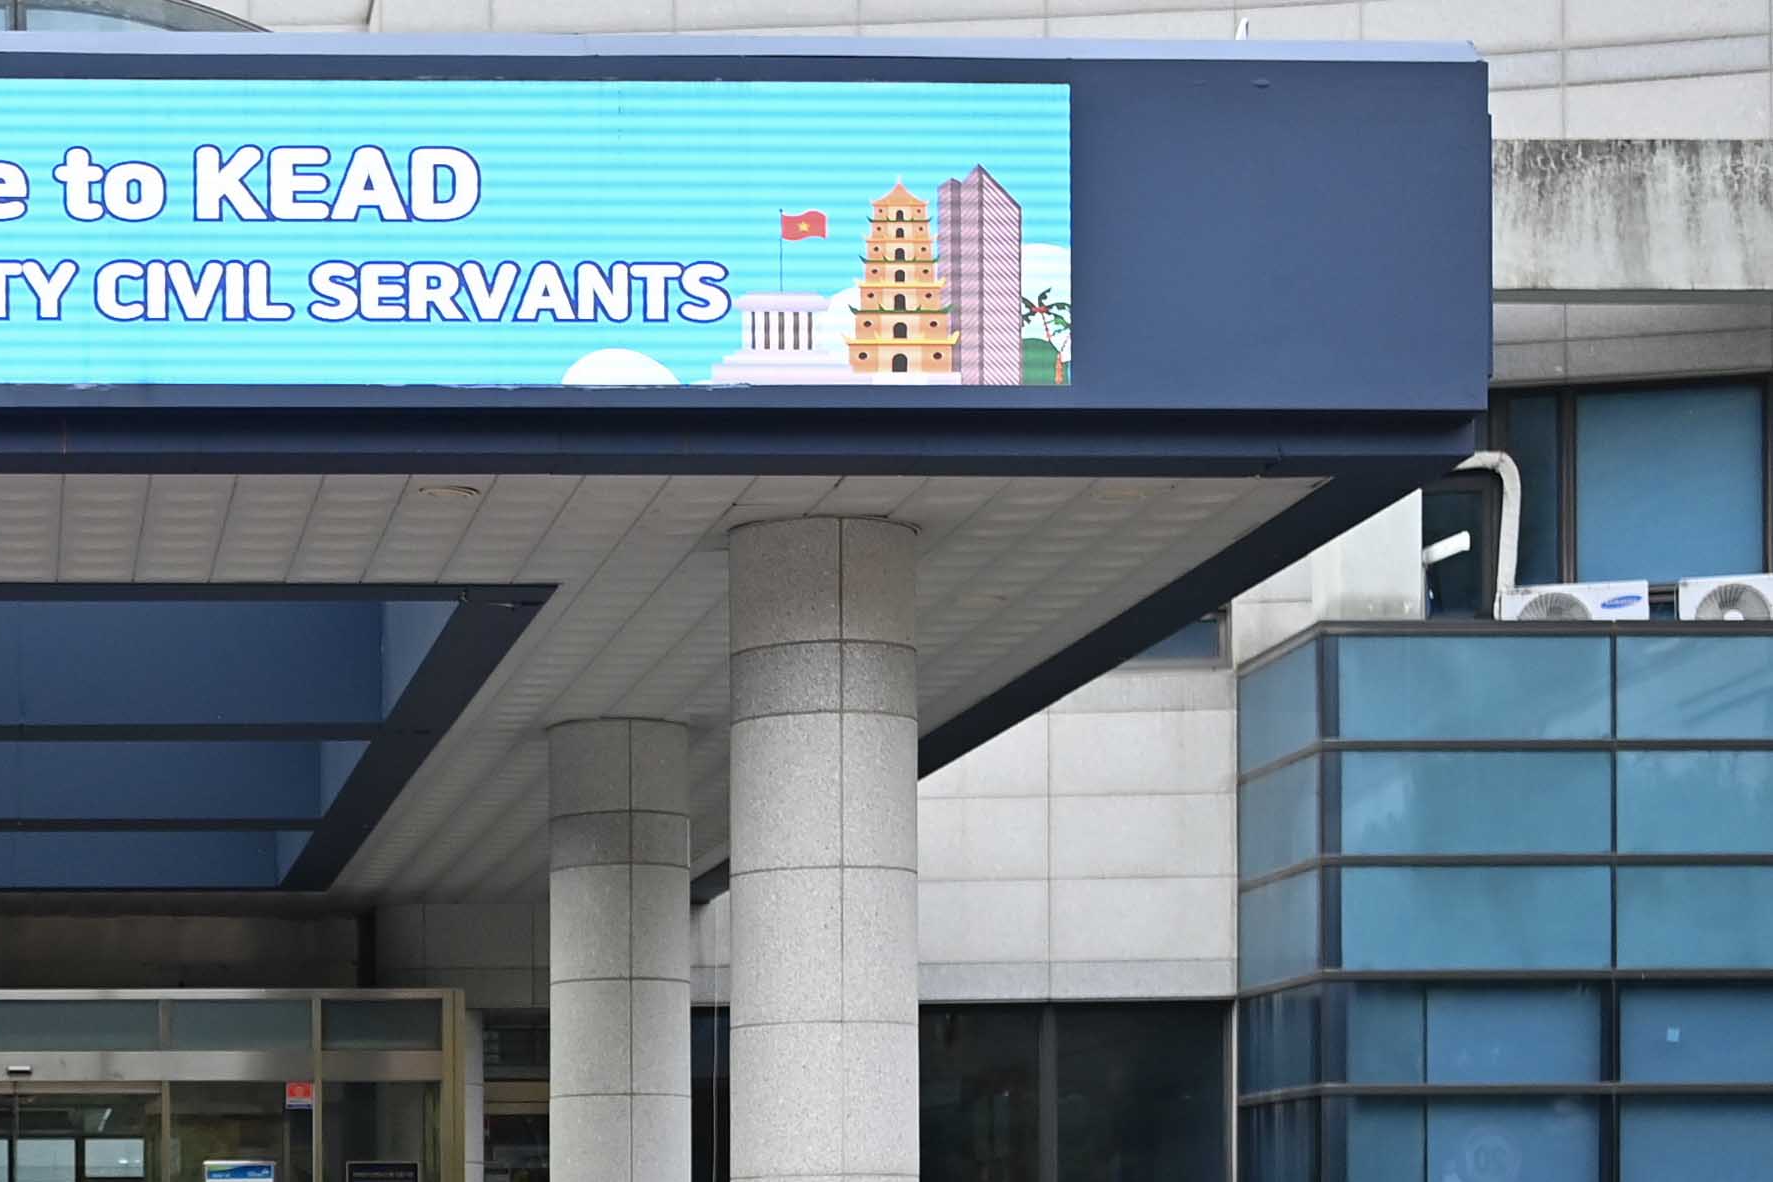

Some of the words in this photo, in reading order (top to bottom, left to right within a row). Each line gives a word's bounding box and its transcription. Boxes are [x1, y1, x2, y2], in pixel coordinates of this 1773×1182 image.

[52, 146, 167, 222] to
[193, 145, 482, 223] KEAD
[94, 259, 295, 322] CIVIL
[308, 260, 731, 323] SERVANTS
